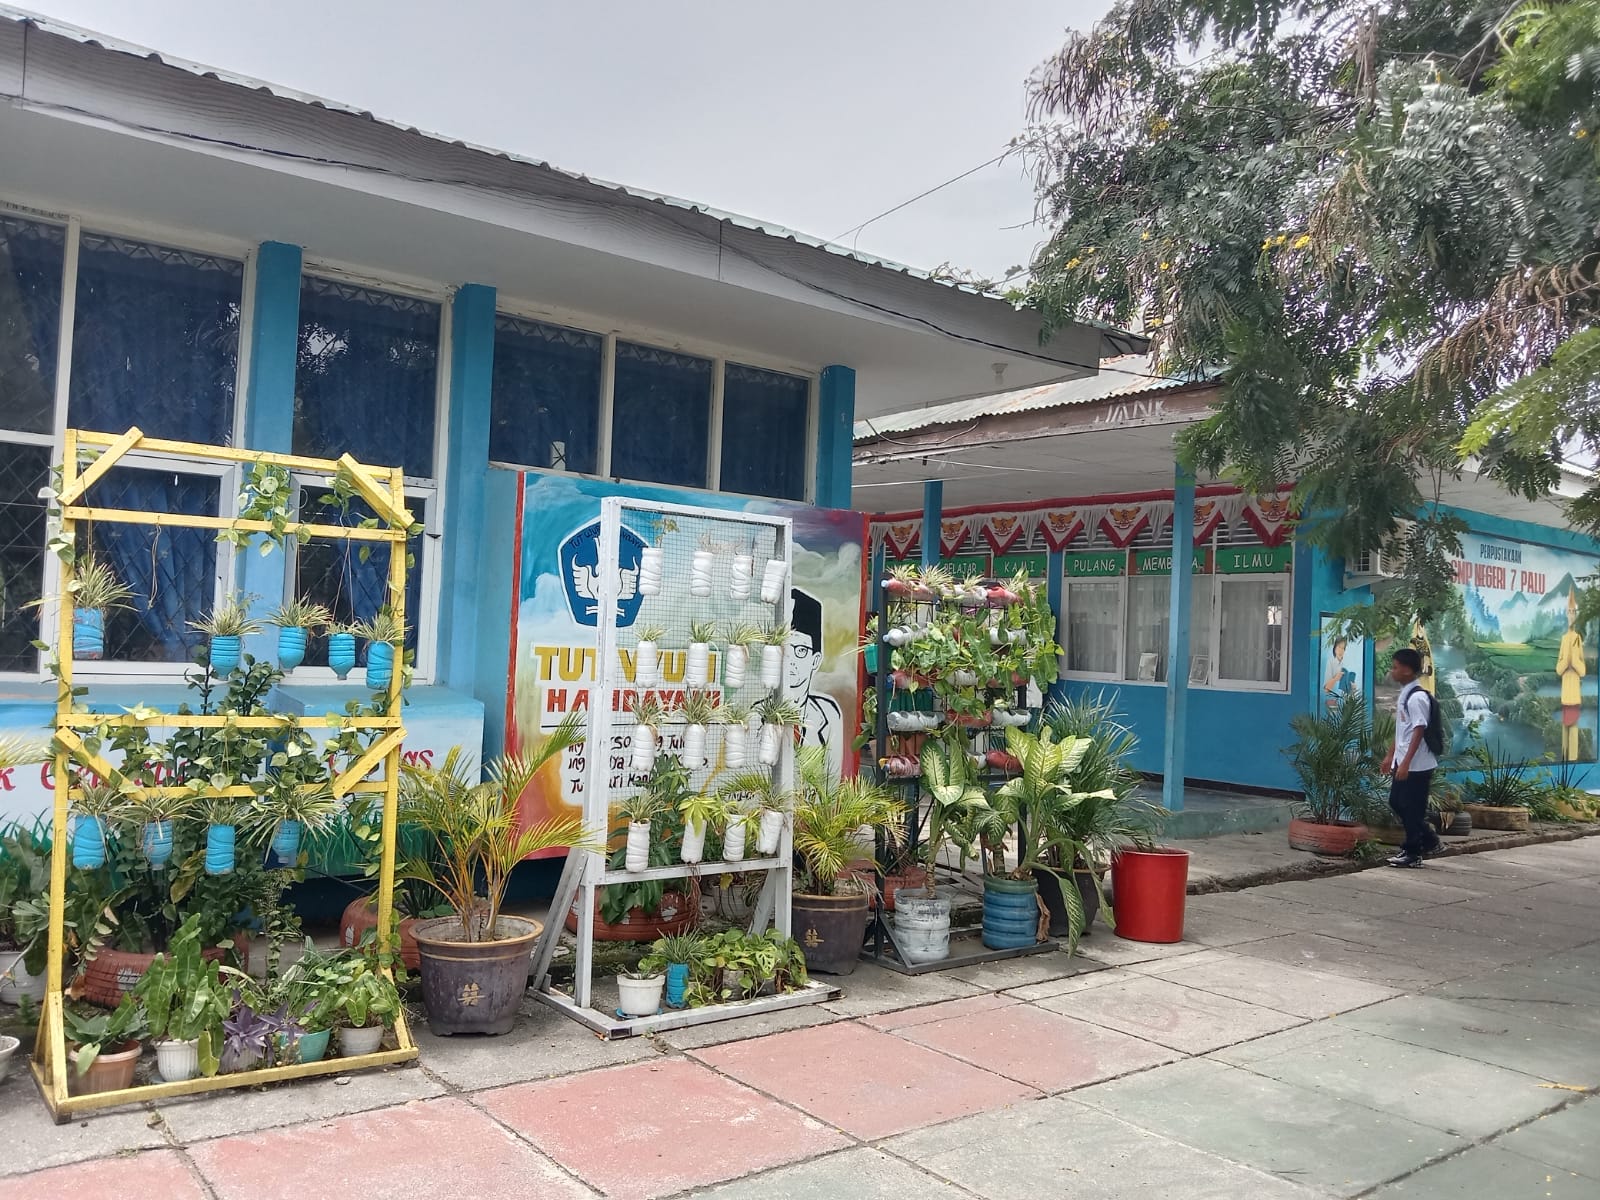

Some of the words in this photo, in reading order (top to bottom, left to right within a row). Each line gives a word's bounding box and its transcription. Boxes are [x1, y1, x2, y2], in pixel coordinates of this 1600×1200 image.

[1073, 558, 1116, 572] PULANG
[1142, 556, 1198, 571] MEMBA
[1233, 553, 1273, 568] ILMU
[1480, 543, 1522, 564] PERPUSTAKAAN
[1475, 563, 1506, 590] NEGERI
[1510, 569, 1517, 591] 7
[1521, 570, 1546, 595] PALU
